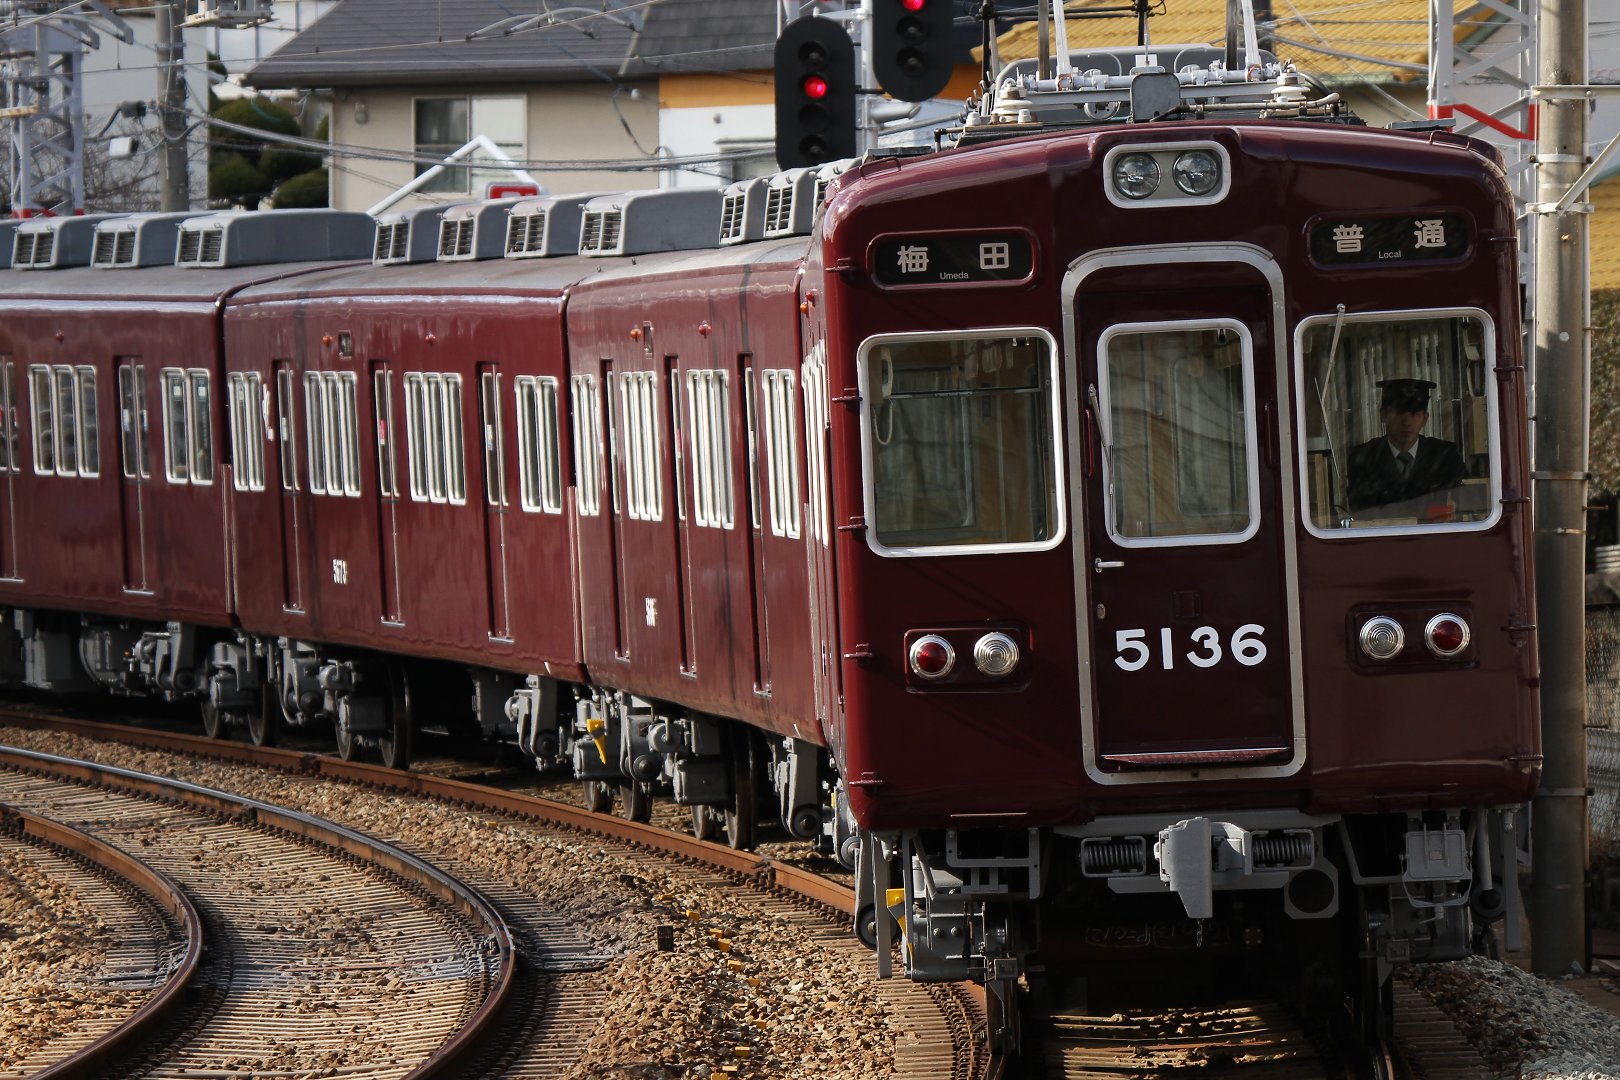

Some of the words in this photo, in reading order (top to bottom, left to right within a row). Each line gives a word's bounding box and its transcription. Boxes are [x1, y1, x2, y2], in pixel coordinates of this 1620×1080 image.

[1332, 219, 1447, 253] 普通
[897, 242, 1010, 274] 梅田
[1378, 250, 1402, 259] Local
[939, 271, 969, 280] Umeda
[1114, 623, 1268, 672] 5136
